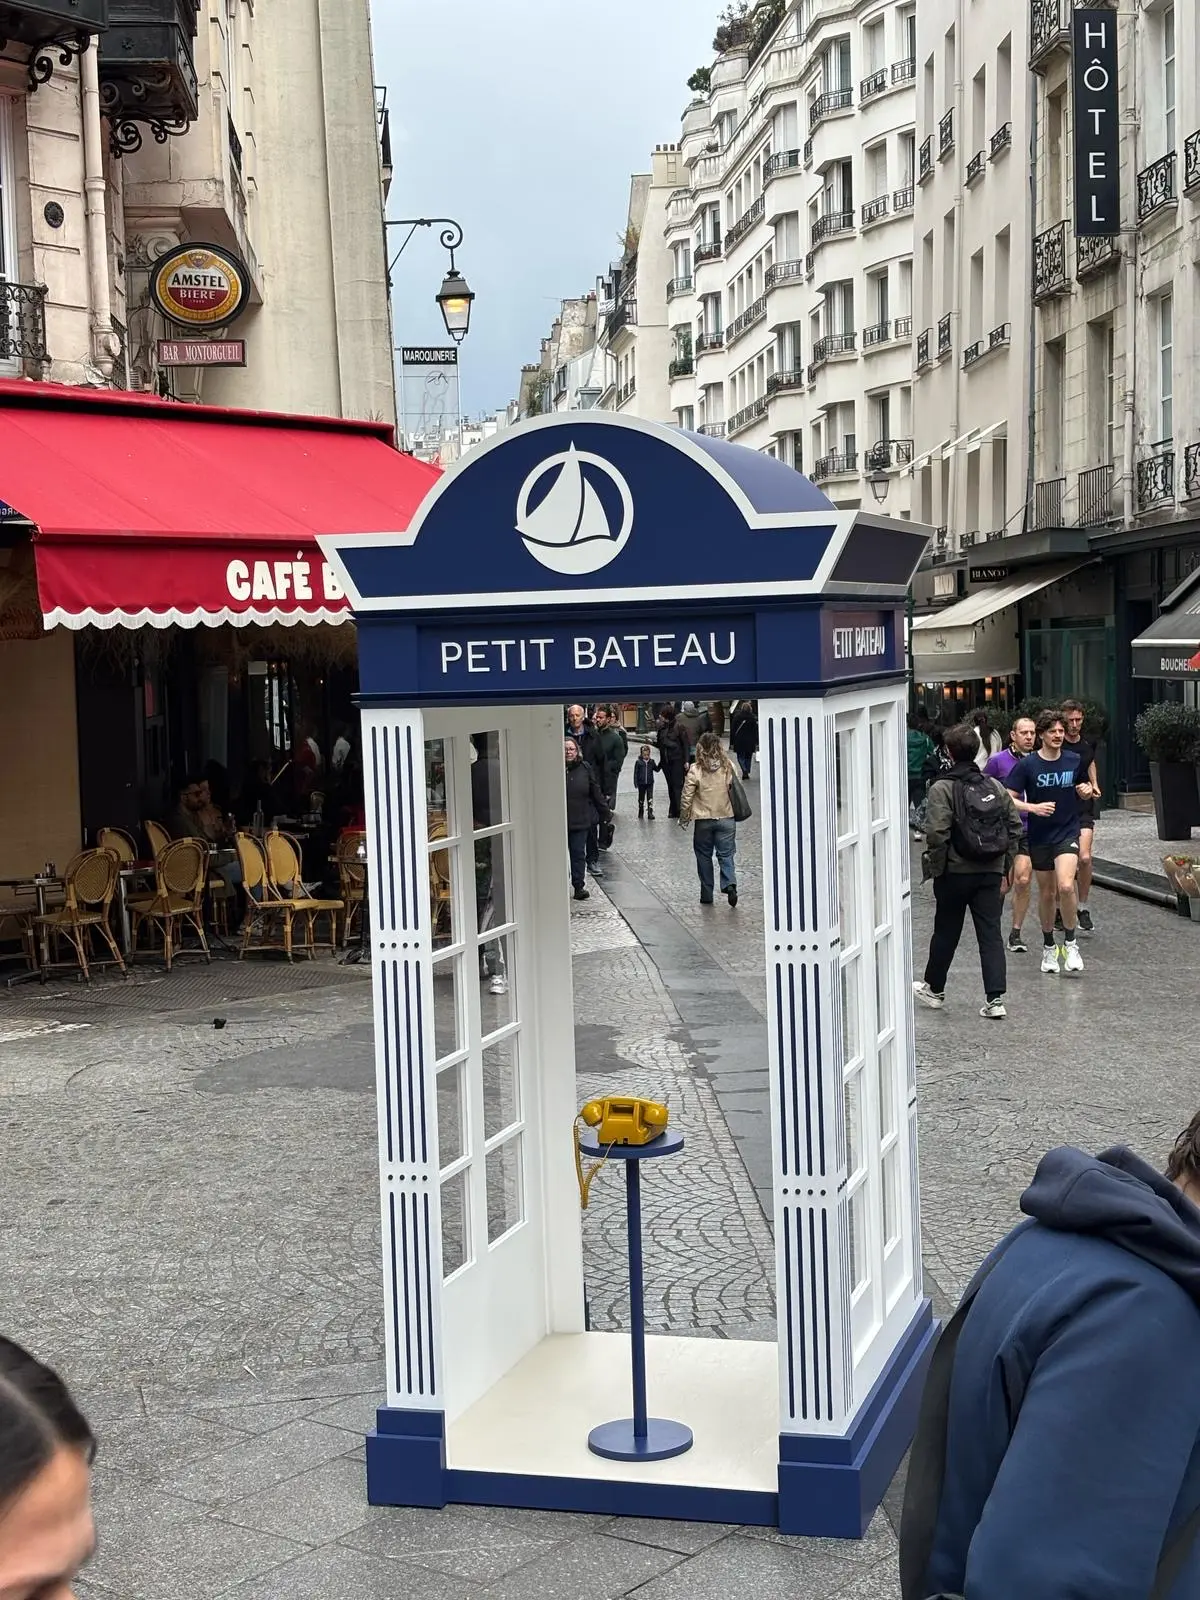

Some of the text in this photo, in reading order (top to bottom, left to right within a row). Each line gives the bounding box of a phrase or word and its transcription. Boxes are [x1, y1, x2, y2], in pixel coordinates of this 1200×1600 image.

[1084, 22, 1109, 222] HÔTEL
[172, 273, 225, 288] AMSTEL
[180, 289, 216, 299] BIERE
[163, 345, 240, 361] BAR MONTORGUEIL
[403, 350, 456, 362] MAROQUINERIE
[226, 550, 313, 601] CAFÉ
[972, 569, 1006, 579] BIANCO
[855, 626, 885, 657] BATEAU
[440, 631, 737, 673] PETIT BATEAU
